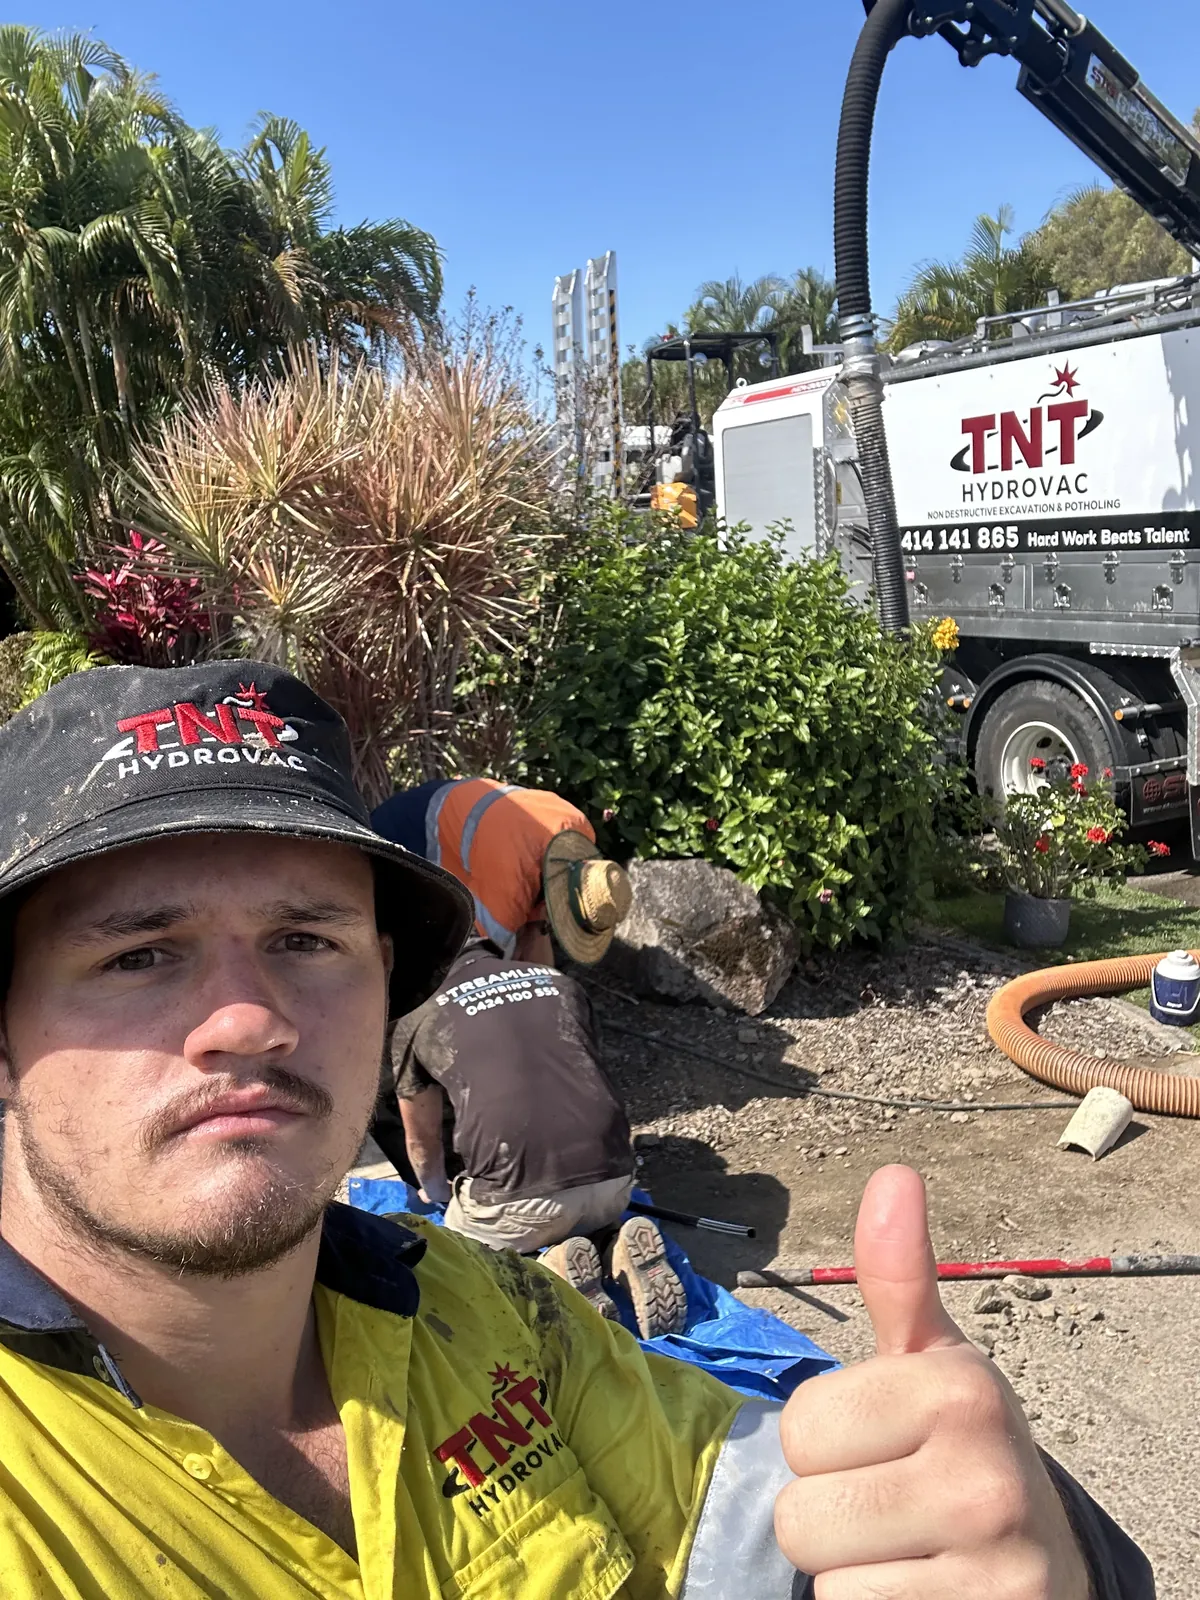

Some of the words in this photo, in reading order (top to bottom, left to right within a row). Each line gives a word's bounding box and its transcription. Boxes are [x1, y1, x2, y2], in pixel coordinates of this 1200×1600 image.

[961, 399, 1089, 475] TNT
[962, 473, 1089, 502] HYDROVAC
[927, 510, 944, 520] NON
[945, 506, 998, 519] DESTRUCTIVE
[999, 502, 1056, 515] EXCAVATION
[1056, 503, 1063, 512] &
[1064, 498, 1121, 512] POTHOLING
[939, 527, 971, 550] 141
[977, 526, 1020, 549] 865
[1027, 529, 1059, 547] Hard
[1061, 529, 1097, 546] Work
[1101, 527, 1142, 546] Beats
[1144, 527, 1190, 544] Talent
[117, 702, 285, 755] TNT
[118, 747, 307, 780] HYDROVAC
[435, 966, 562, 1007] STREAMLINE
[458, 980, 532, 1008] PLUMBING
[465, 995, 505, 1017] 0424
[505, 989, 533, 1004] 100
[534, 986, 560, 998] 555
[432, 1375, 553, 1489] TNT
[468, 1428, 564, 1518] HYDROVA
